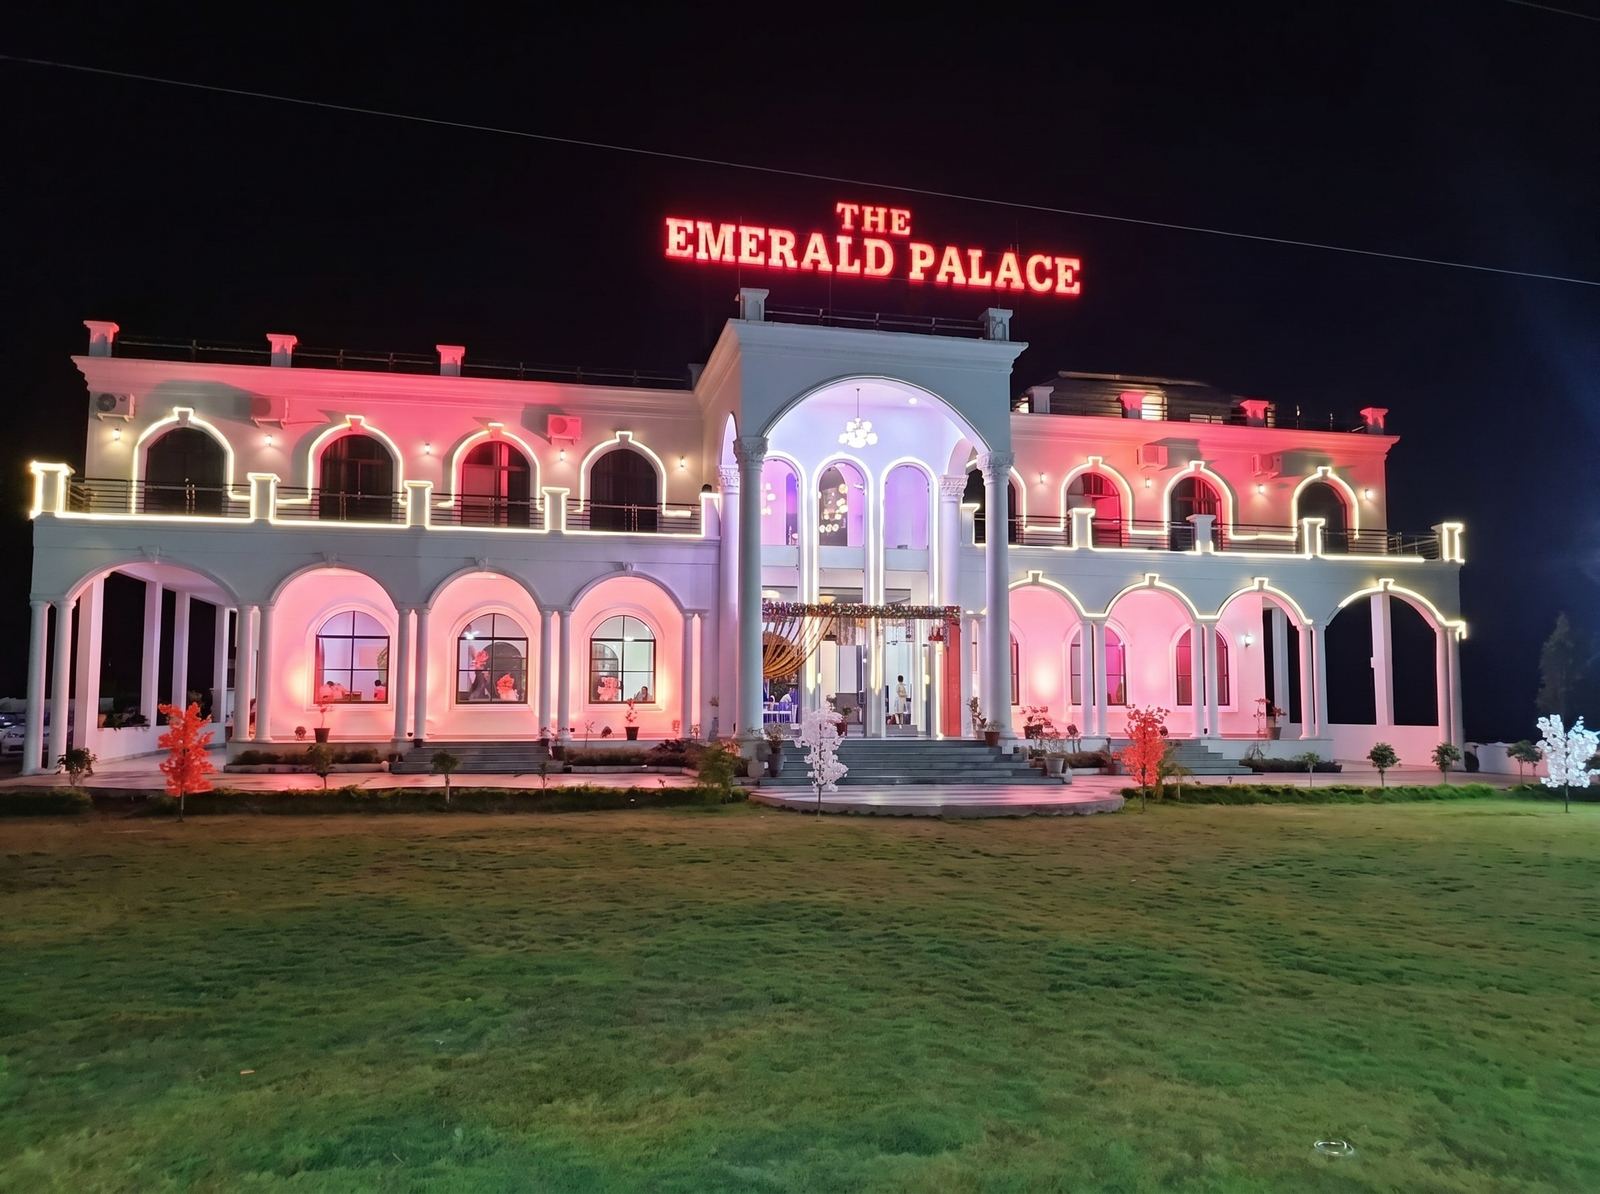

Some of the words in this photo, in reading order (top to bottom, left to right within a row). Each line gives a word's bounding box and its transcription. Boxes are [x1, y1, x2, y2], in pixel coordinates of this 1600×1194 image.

[836, 203, 911, 236] THE
[665, 217, 894, 279] EMERALD
[908, 242, 1081, 296] PALACE
